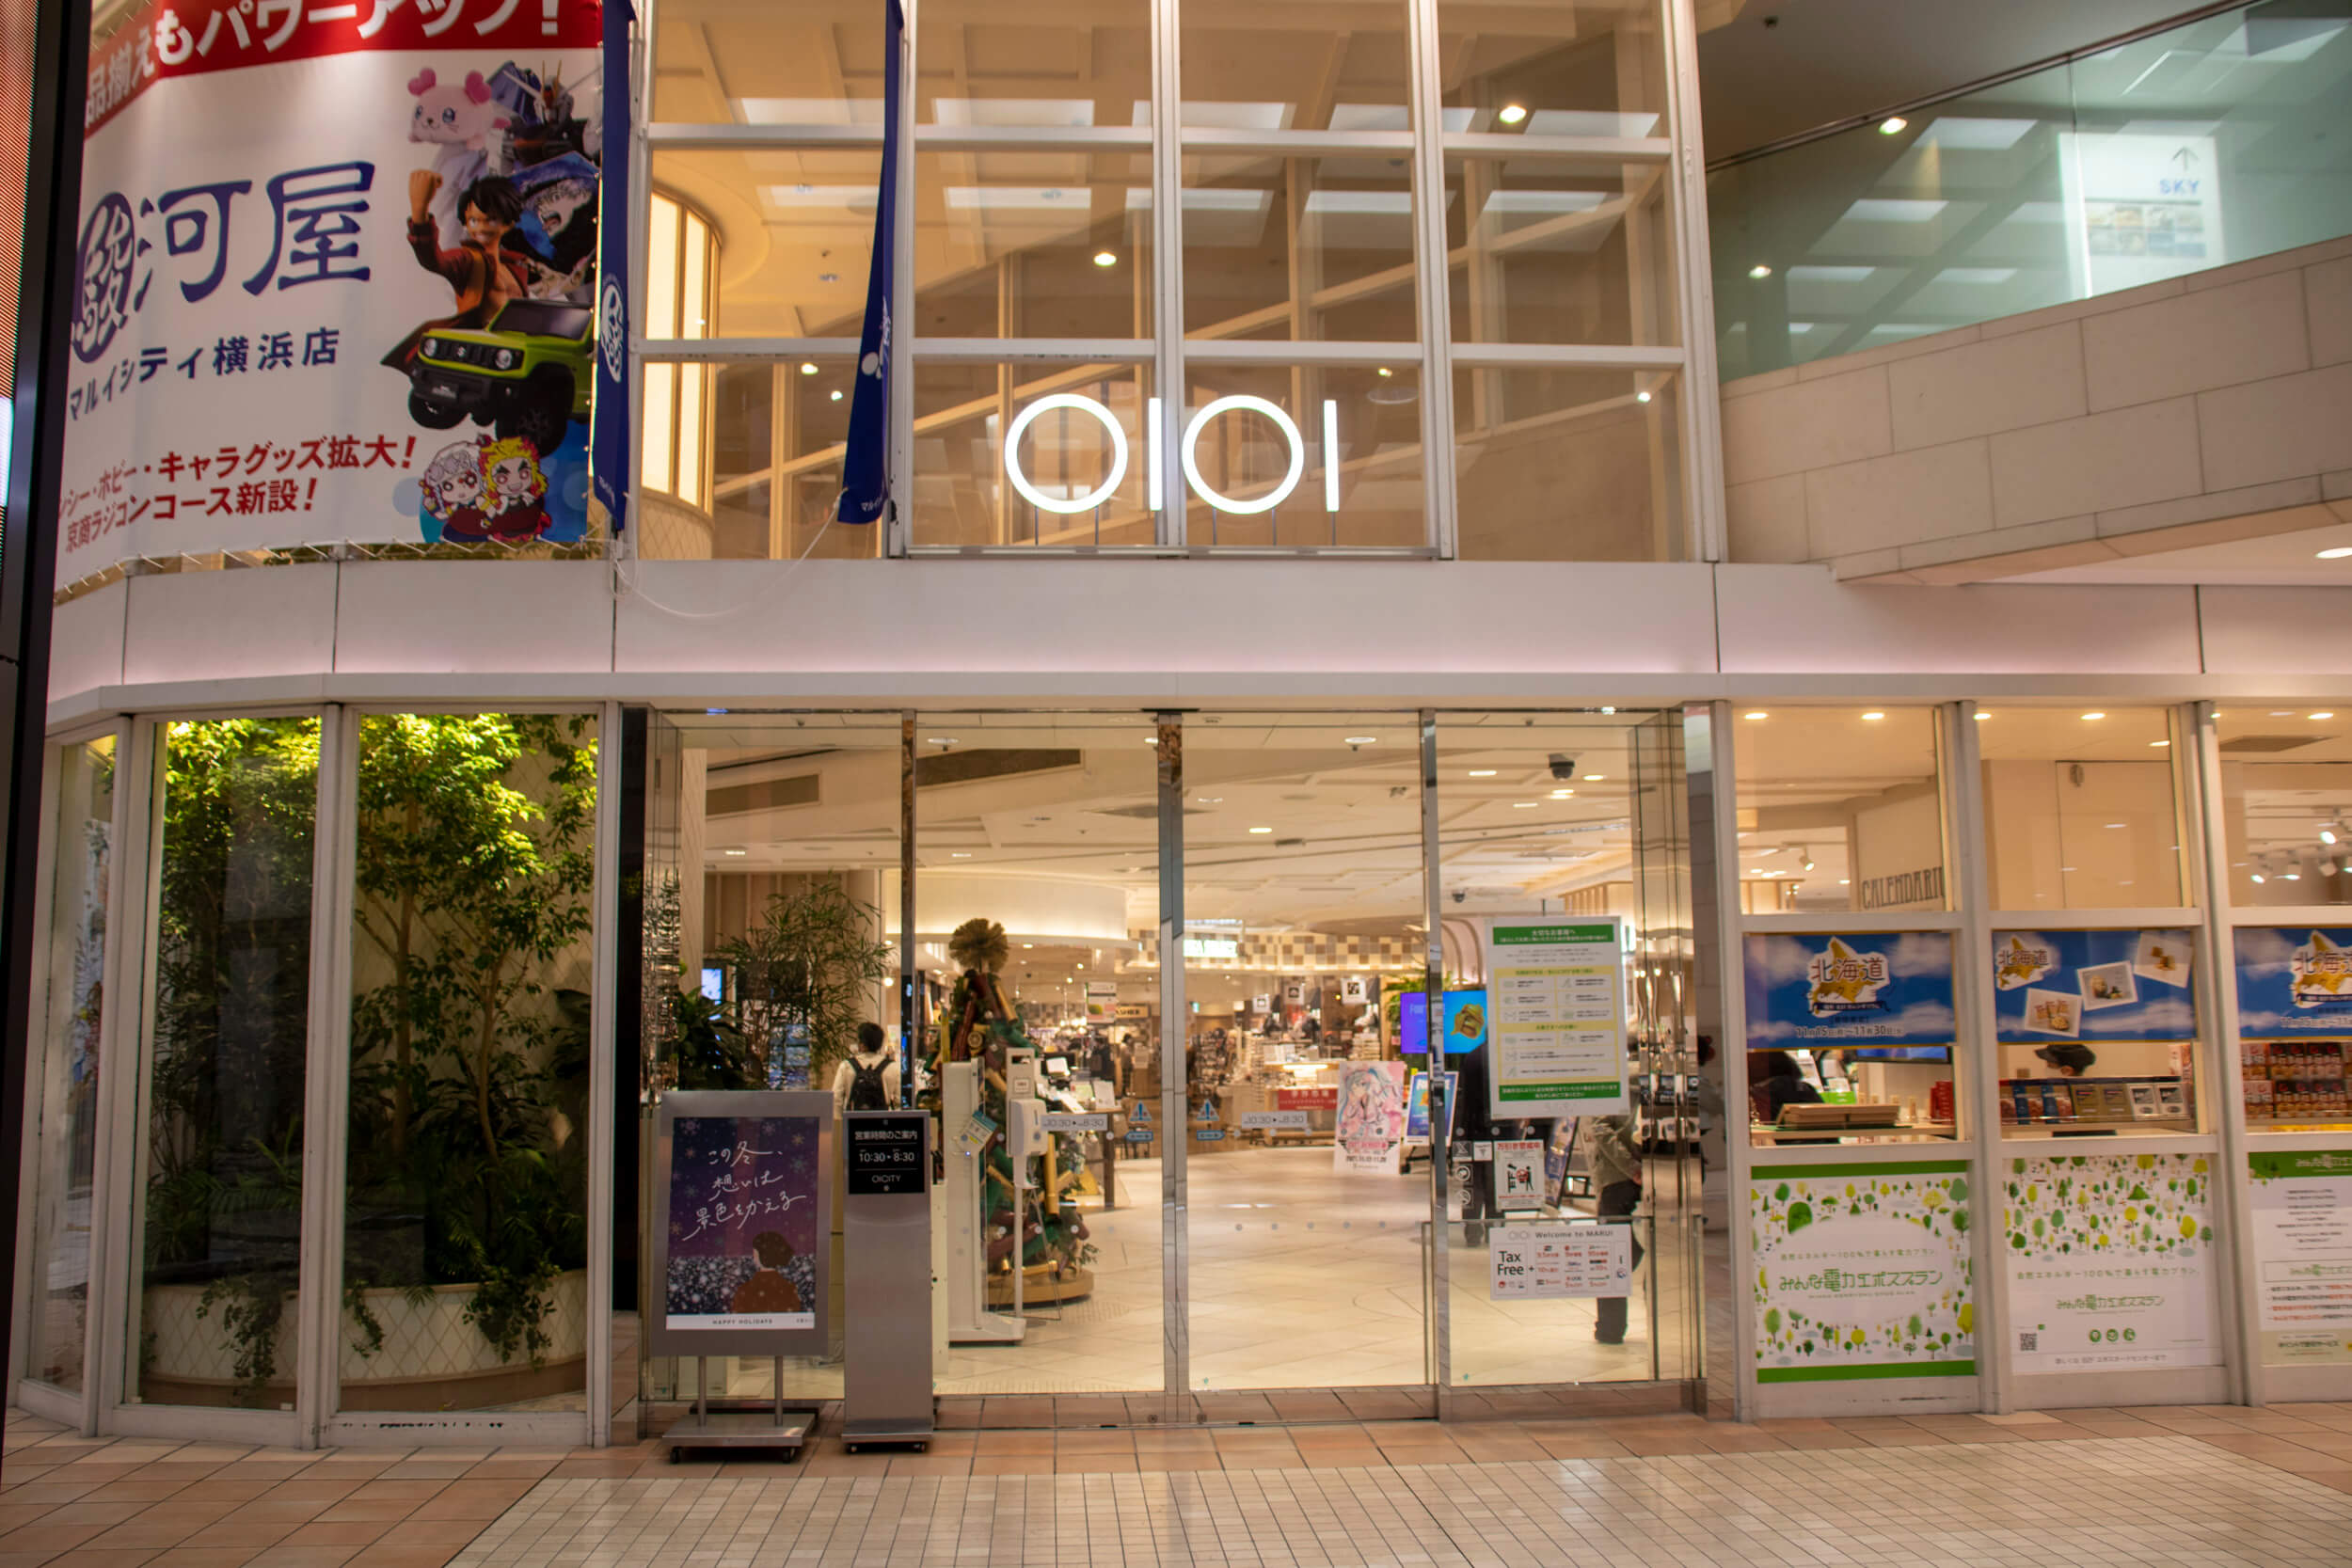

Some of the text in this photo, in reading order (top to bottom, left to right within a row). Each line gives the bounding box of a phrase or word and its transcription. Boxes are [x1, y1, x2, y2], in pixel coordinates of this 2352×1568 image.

[2159, 179, 2201, 195] SKY
[70, 326, 340, 421] マルイシティ横浜店
[66, 478, 317, 554] 京商ラジコンコース新設！
[1996, 949, 2049, 966] 北海道
[1810, 957, 1885, 982] 北海道
[859, 1151, 915, 1163] 10:30 8:30
[708, 1170, 783, 1202] 想いは
[682, 1191, 806, 1241] 景色をかえる
[1498, 1250, 1521, 1262] Tax
[1497, 1263, 1525, 1275] Free
